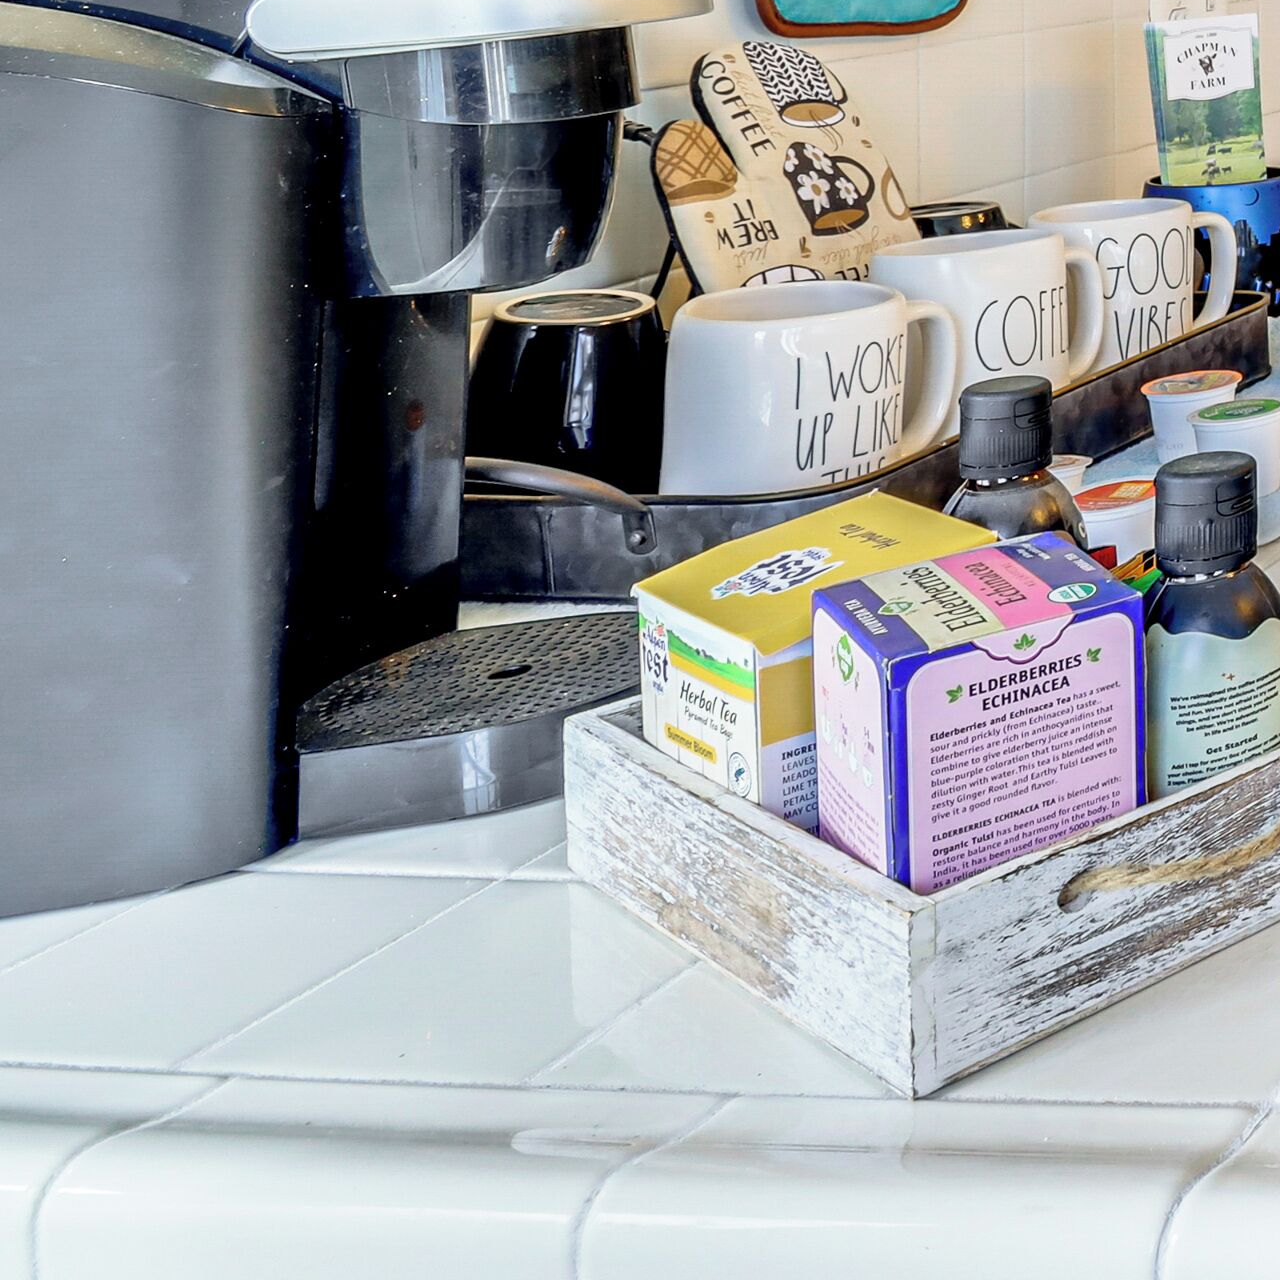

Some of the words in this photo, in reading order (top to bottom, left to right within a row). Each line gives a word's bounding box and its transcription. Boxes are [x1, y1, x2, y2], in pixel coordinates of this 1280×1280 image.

[1177, 42, 1237, 64] CHAPMAN
[1190, 77, 1227, 90] FARM
[701, 60, 776, 157] COFFEE
[733, 199, 757, 221] IT
[717, 219, 779, 250] BREW
[1096, 225, 1192, 299] GOOD
[975, 286, 1070, 372] COFFE
[796, 357, 801, 410] I
[825, 334, 904, 402] WOKE
[796, 412, 834, 472] UP
[852, 393, 900, 458] LIKE
[839, 523, 865, 538] Tea
[859, 531, 901, 550] Herbal
[843, 598, 859, 614] TEA
[901, 566, 988, 632] Elderberries
[964, 561, 1028, 608] Echinacea
[968, 653, 1081, 697] ELDERBERRIES
[982, 675, 1070, 711] ECHINACEA
[680, 680, 717, 714] Herbal
[720, 699, 737, 725] Tea
[684, 705, 708, 726] Pyramid
[709, 720, 718, 731] Tea
[930, 720, 986, 741] Elderberries
[989, 713, 1006, 725] and
[1009, 701, 1053, 719] Echinacea
[1056, 696, 1070, 705] Tea
[1072, 691, 1087, 700] has
[667, 726, 692, 749] Summer
[693, 740, 714, 760] Bloom
[930, 742, 950, 753] sour
[951, 735, 968, 747] and
[971, 727, 1000, 743] prickly
[1002, 720, 1026, 733] (from
[1028, 704, 1074, 725] Echinacea)
[930, 744, 984, 764] Elderberries
[986, 739, 1000, 749] are
[1002, 733, 1019, 744] rich
[1031, 711, 1094, 735] anthocyanidins
[1096, 704, 1112, 715] that
[930, 760, 969, 776] combine
[982, 751, 1000, 762] give
[1002, 737, 1047, 755] elderberry
[1047, 730, 1068, 743] juice
[1070, 726, 1080, 734] an
[1082, 716, 1112, 730] intense
[1206, 742, 1223, 755] Get
[1225, 733, 1258, 751] Started
[930, 767, 983, 787] blue-purple
[985, 753, 1029, 771] coloration
[1031, 746, 1049, 757] that
[1050, 739, 1073, 751] turns
[1074, 728, 1105, 744] reddish
[1106, 725, 1117, 733] on
[930, 783, 966, 799] dilution
[969, 776, 988, 787] with
[1036, 758, 1050, 767] tea
[1052, 754, 1059, 762] is
[1061, 742, 1094, 759] blended
[1095, 736, 1113, 747] with
[782, 782, 805, 796] LIME
[931, 798, 954, 810] zesty
[956, 789, 986, 803] Ginger
[987, 781, 1008, 793] Root
[1012, 774, 1028, 786] and
[1030, 766, 1057, 780] Earthy
[1059, 758, 1078, 770] Tulsi
[1080, 750, 1107, 764] Leaves
[784, 807, 803, 821] MAY
[931, 811, 950, 823] give
[952, 807, 959, 815] it
[968, 797, 990, 812] good
[993, 785, 1029, 803] rounded
[932, 818, 992, 842] ELDERBERRIES
[994, 803, 1039, 823] ECHINACEA
[1041, 797, 1055, 807] TEA
[1057, 794, 1064, 802] is
[1066, 781, 1099, 799] blended
[932, 840, 968, 856] Organic
[971, 831, 993, 844] Tulsi
[995, 827, 1011, 837] has
[1013, 819, 1034, 831] been
[1036, 810, 1056, 823] used
[1058, 807, 1070, 816] for
[1071, 793, 1110, 811] centuries
[932, 852, 965, 867] restore
[967, 841, 1001, 857] balance
[1003, 833, 1019, 845] and
[1021, 821, 1059, 839] harmony
[1060, 817, 1069, 825] in
[1071, 812, 1085, 822] the
[1111, 800, 1120, 808] In
